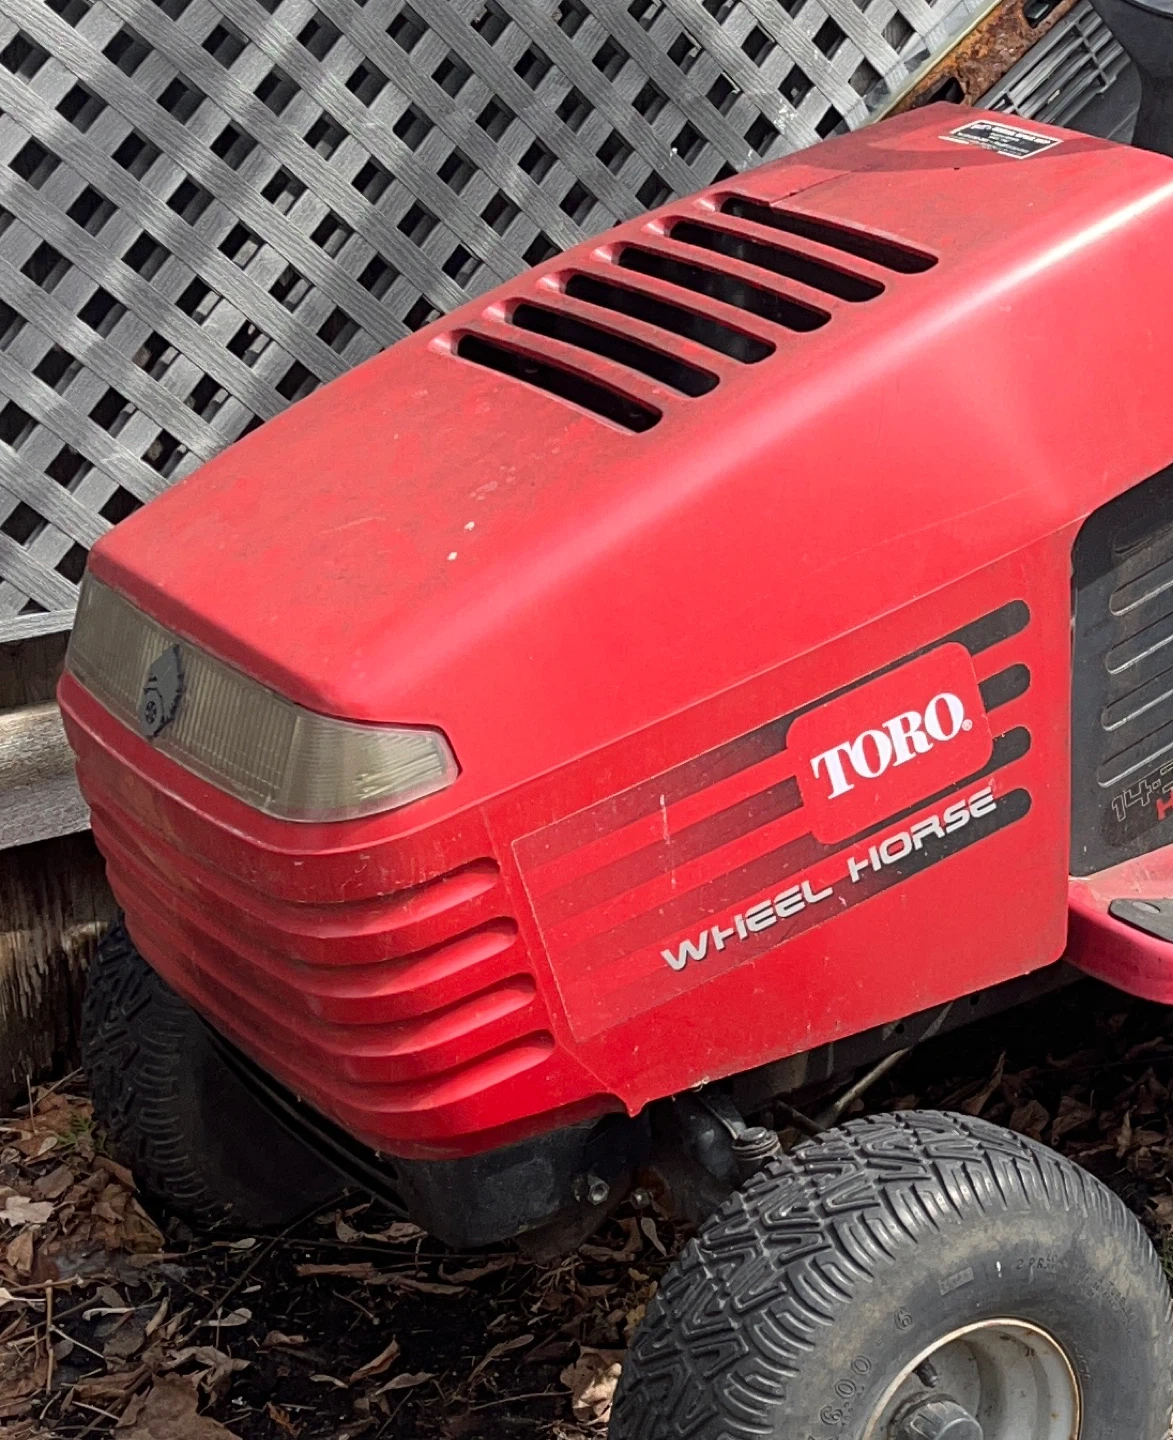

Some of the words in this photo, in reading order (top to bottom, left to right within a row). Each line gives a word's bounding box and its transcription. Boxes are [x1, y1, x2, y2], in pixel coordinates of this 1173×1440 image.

[811, 692, 966, 800] TORO
[661, 880, 833, 972] WHEEL
[848, 787, 998, 883] HORSE
